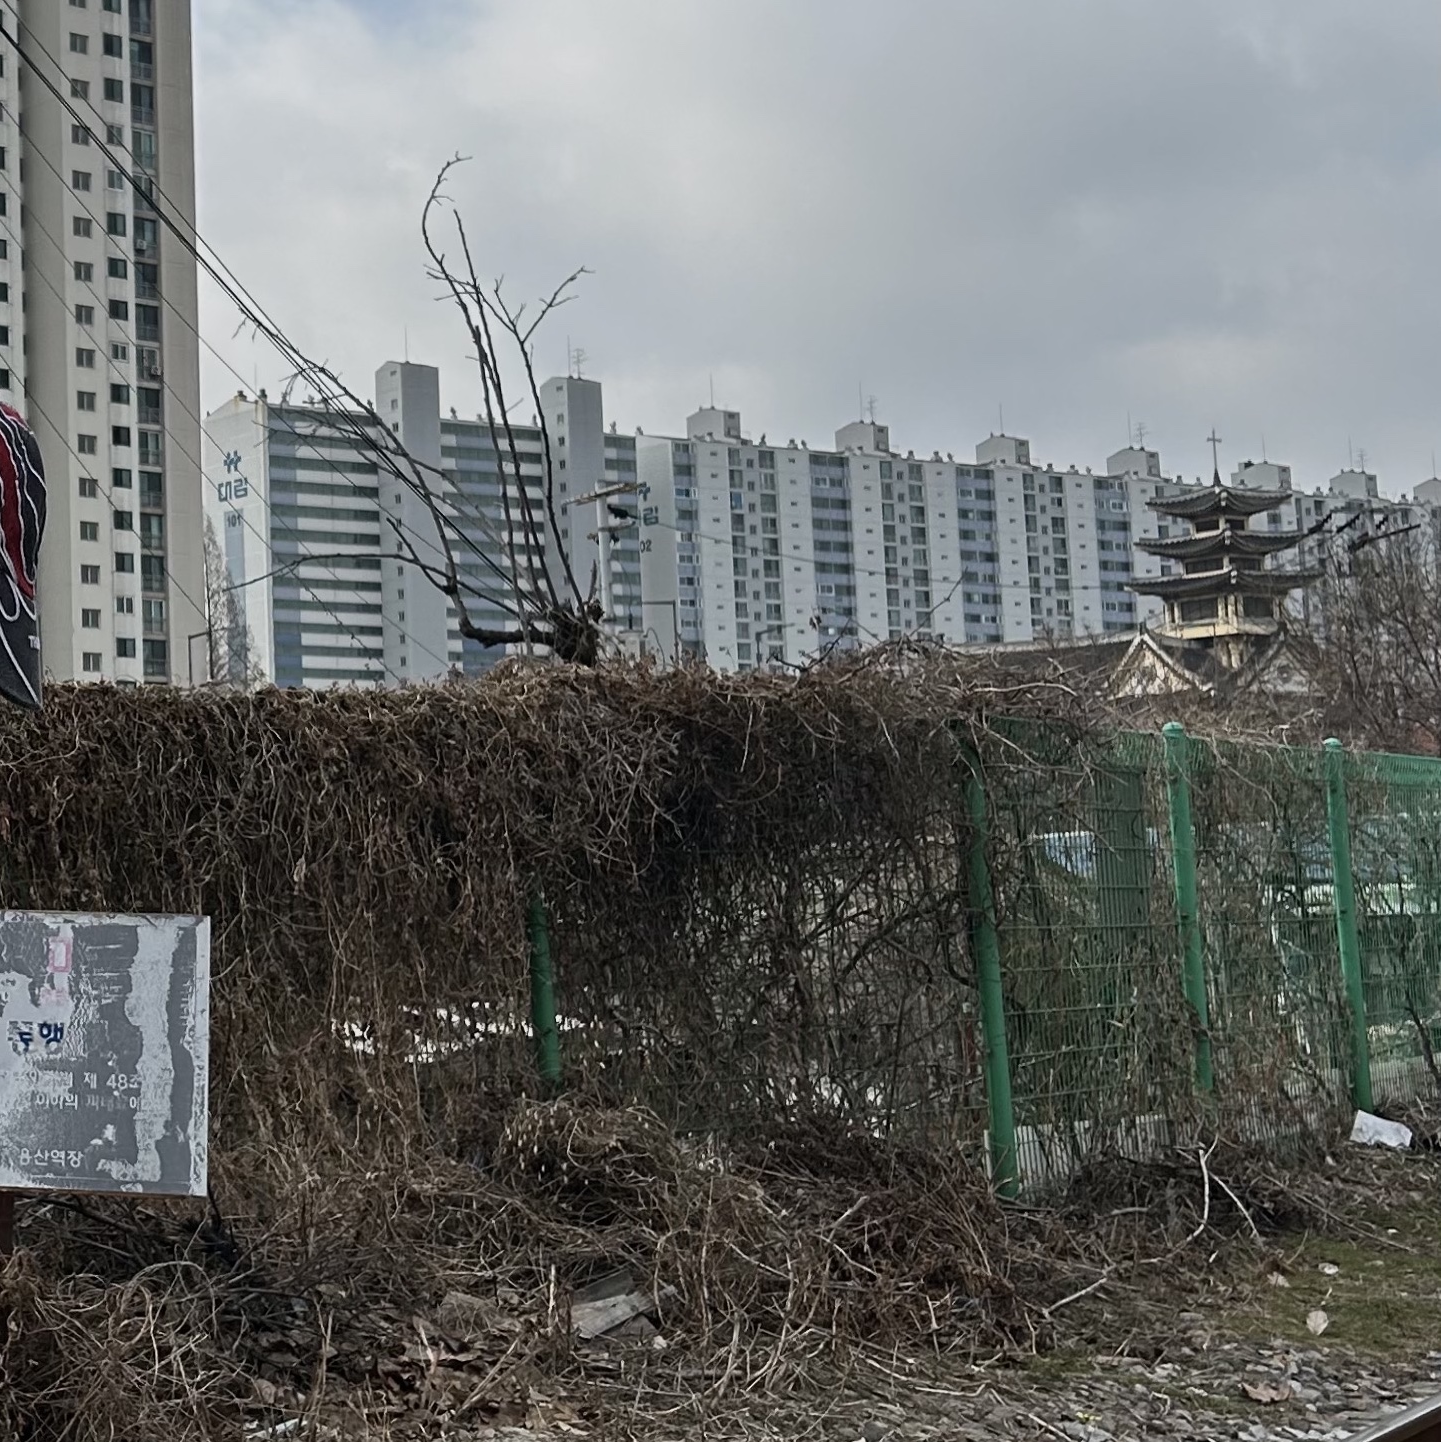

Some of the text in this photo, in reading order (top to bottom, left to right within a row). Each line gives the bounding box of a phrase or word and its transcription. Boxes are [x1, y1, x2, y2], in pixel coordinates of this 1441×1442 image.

[218, 477, 248, 503] 대림
[226, 514, 241, 528] 101
[83, 1071, 98, 1090] 제
[19, 1147, 84, 1168] 용산역장
